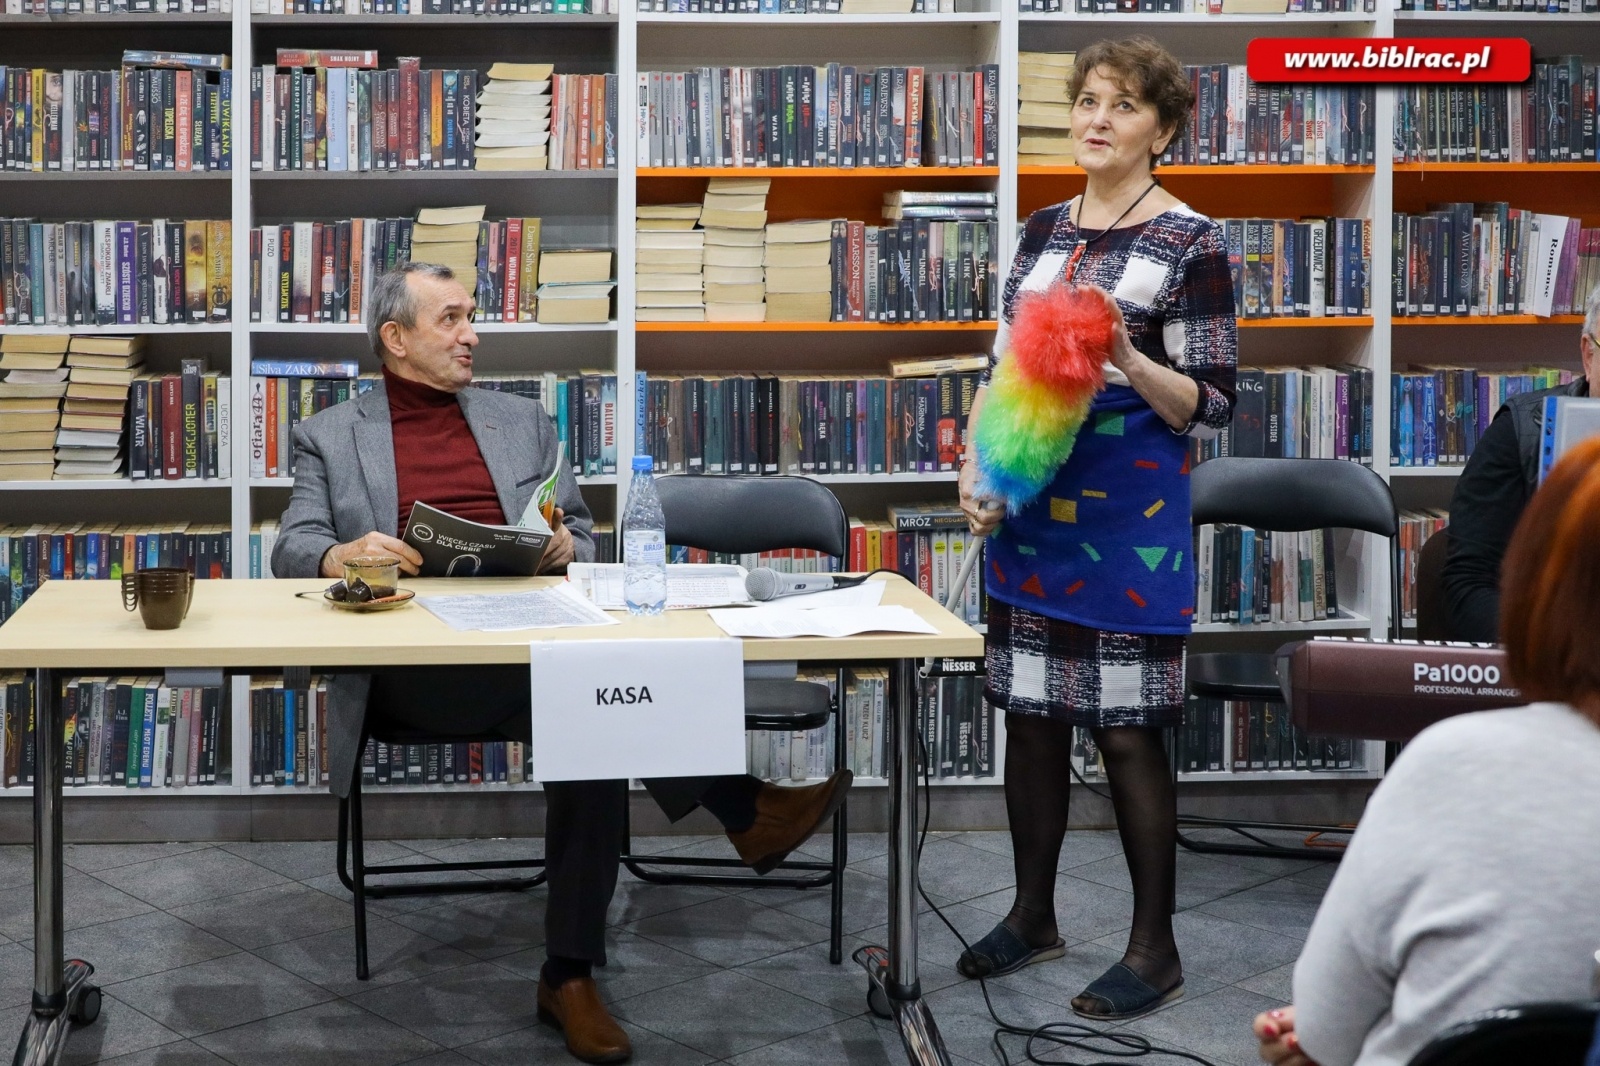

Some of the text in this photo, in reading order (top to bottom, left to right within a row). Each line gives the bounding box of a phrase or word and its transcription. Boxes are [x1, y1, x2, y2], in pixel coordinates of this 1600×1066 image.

[151, 76, 159, 104] MUSSO
[880, 72, 888, 117] KRAJEWSKI
[911, 74, 919, 125] KRAJEWSKI
[988, 69, 996, 114] KRAJEWSKI
[461, 94, 470, 127] KOBIETA,
[195, 120, 204, 147] SŁUŻĄCA
[222, 100, 231, 155] UWIKŁANA
[829, 120, 837, 150] EPIDEMIA
[1305, 120, 1315, 141] Świst
[1316, 120, 1325, 141] Świst
[937, 207, 957, 215] LINK
[267, 238, 275, 258] PUZO
[526, 225, 536, 251] Daniel
[1312, 228, 1324, 272] GRZĘDOWICZ
[508, 256, 517, 281] WOJNA
[525, 252, 535, 273] Silva
[852, 238, 860, 280] LARSSON
[918, 258, 926, 287] LINDELL
[1396, 256, 1405, 277] Żółte
[1460, 231, 1471, 290] AWIATORZY
[1543, 238, 1559, 299] Romanse
[122, 261, 132, 311] SZÓSTE DZIECKO
[505, 288, 515, 311] ROSJĄ
[1393, 278, 1404, 297] ptaki
[256, 364, 325, 376] Silva ZAKON
[941, 377, 950, 416] MARININA
[961, 377, 970, 416] MARININA
[1236, 381, 1264, 393] KING
[135, 414, 145, 448] WIATR
[220, 403, 228, 447] UCIECZKA
[604, 402, 614, 447] BALLADYNA
[818, 422, 826, 440] RĘKA
[1269, 414, 1278, 443] OUTSIDER
[899, 516, 932, 528] MRÓZ
[436, 539, 482, 553] DLA CIEBIE
[438, 533, 497, 551] WIĘCEJ CZASU
[942, 661, 976, 672] NESSER
[1413, 662, 1501, 685] Pa1000
[596, 686, 653, 706] KASA
[1414, 684, 1475, 696] PROFESSIONAL
[143, 693, 154, 745] FOLLETT MŁOT
[861, 700, 869, 740] TRZECI KLUCZ
[928, 696, 937, 743] HÅKAN NESSER
[296, 731, 306, 758] Connelly
[959, 722, 968, 758] NESSER
